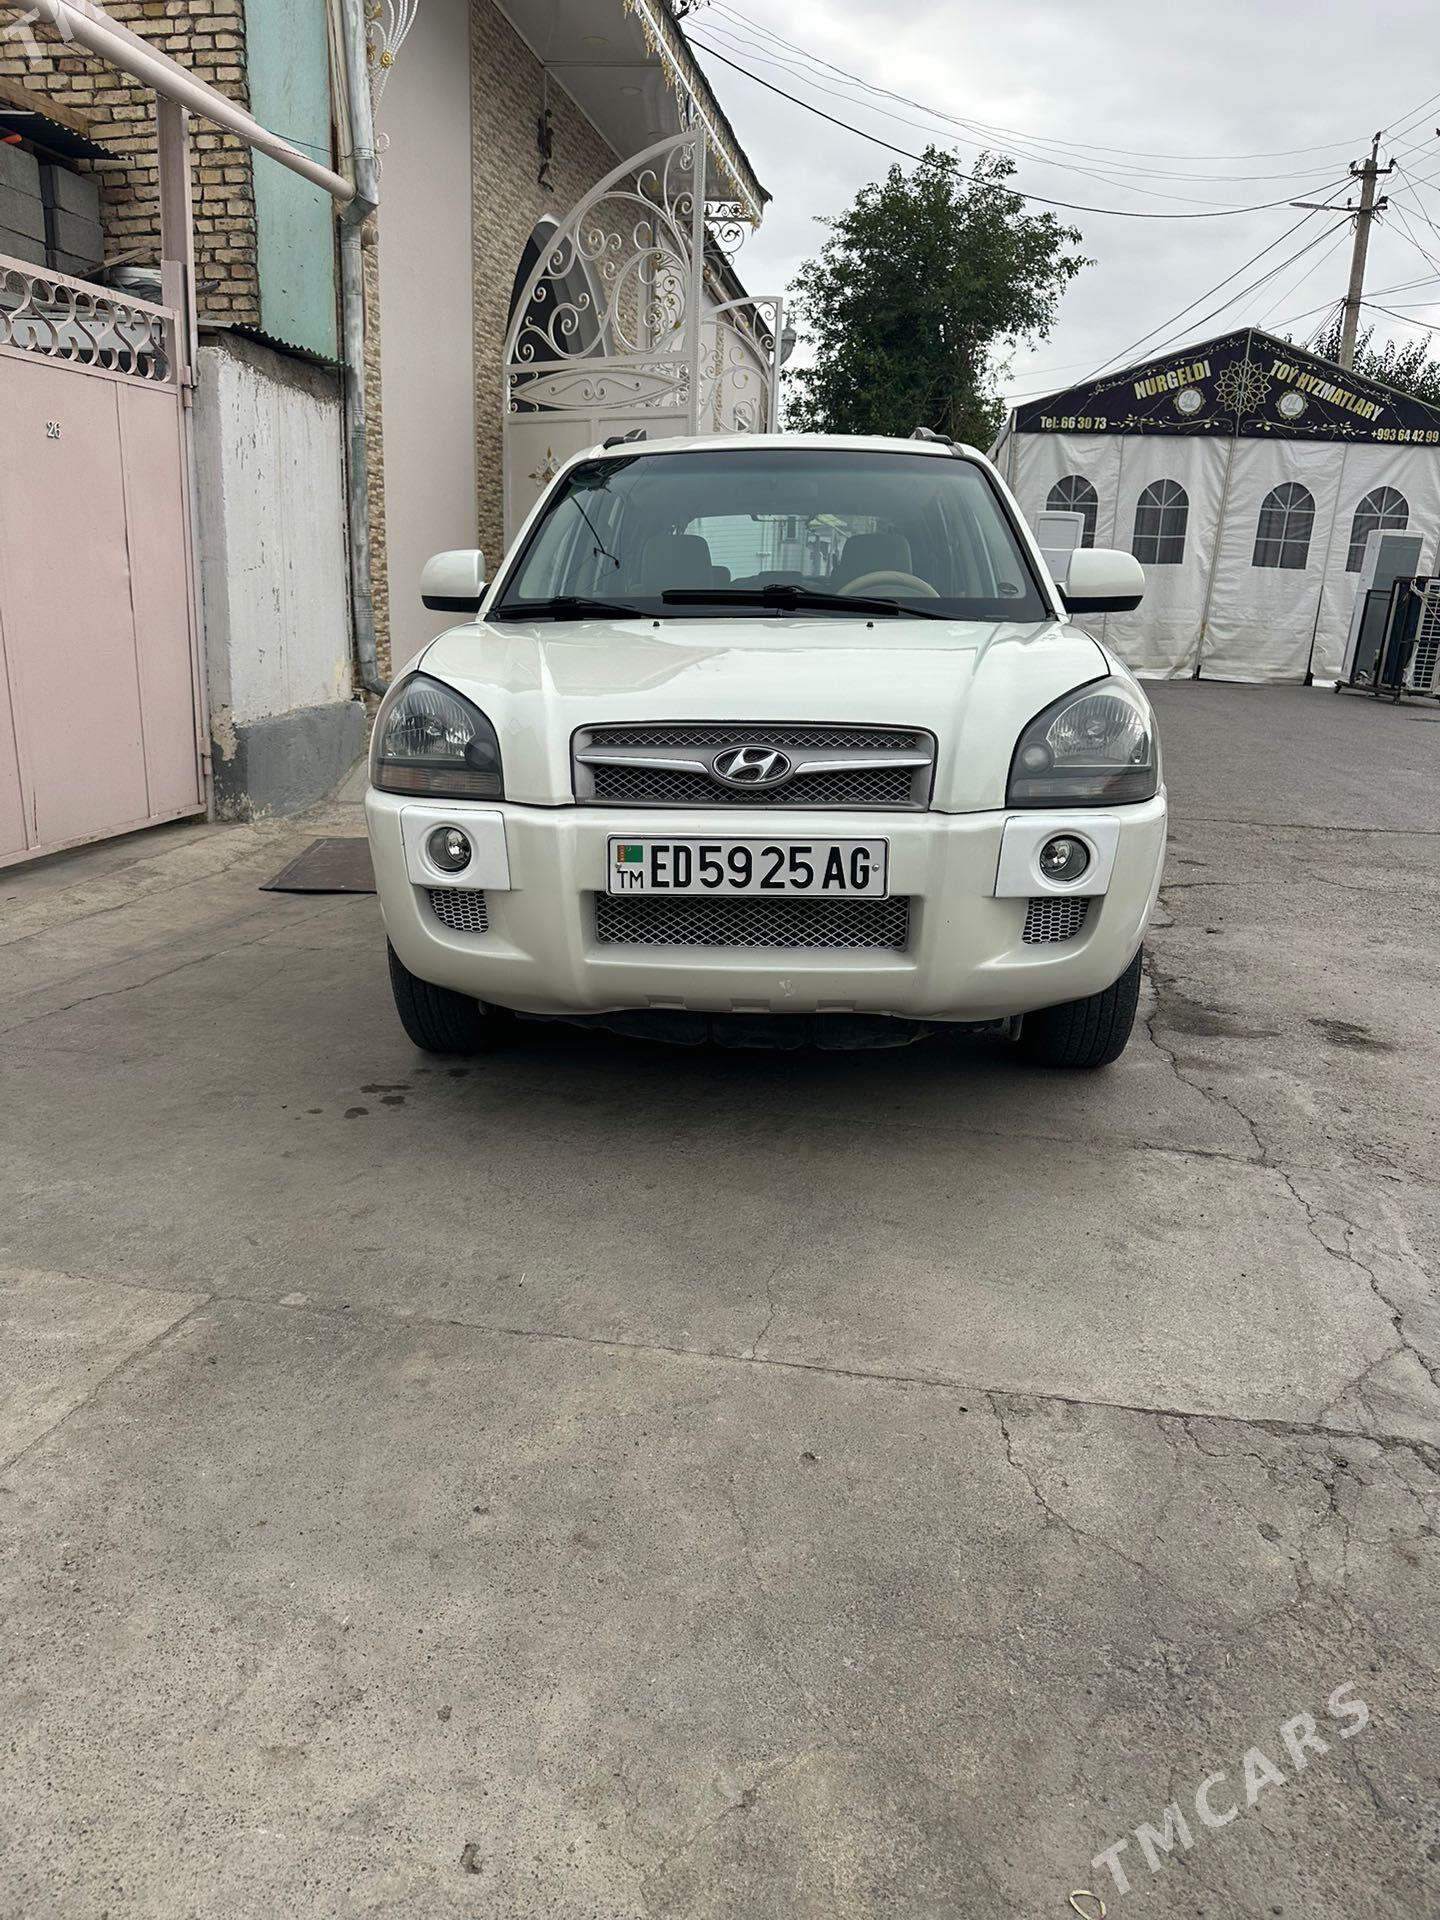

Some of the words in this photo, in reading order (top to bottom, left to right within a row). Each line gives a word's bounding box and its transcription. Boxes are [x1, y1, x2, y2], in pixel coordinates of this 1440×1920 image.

[1134, 360, 1211, 399] NURGELDI
[1295, 373, 1384, 422] HYZMATLARY
[46, 420, 61, 440] 26
[1061, 416, 1076, 429] 66
[1078, 416, 1092, 429] 30
[1094, 417, 1107, 430] 73
[1371, 428, 1396, 441] +993
[1397, 429, 1411, 442] 64
[1412, 429, 1424, 442] 42
[1425, 430, 1439, 443] 99
[617, 870, 643, 889] TM
